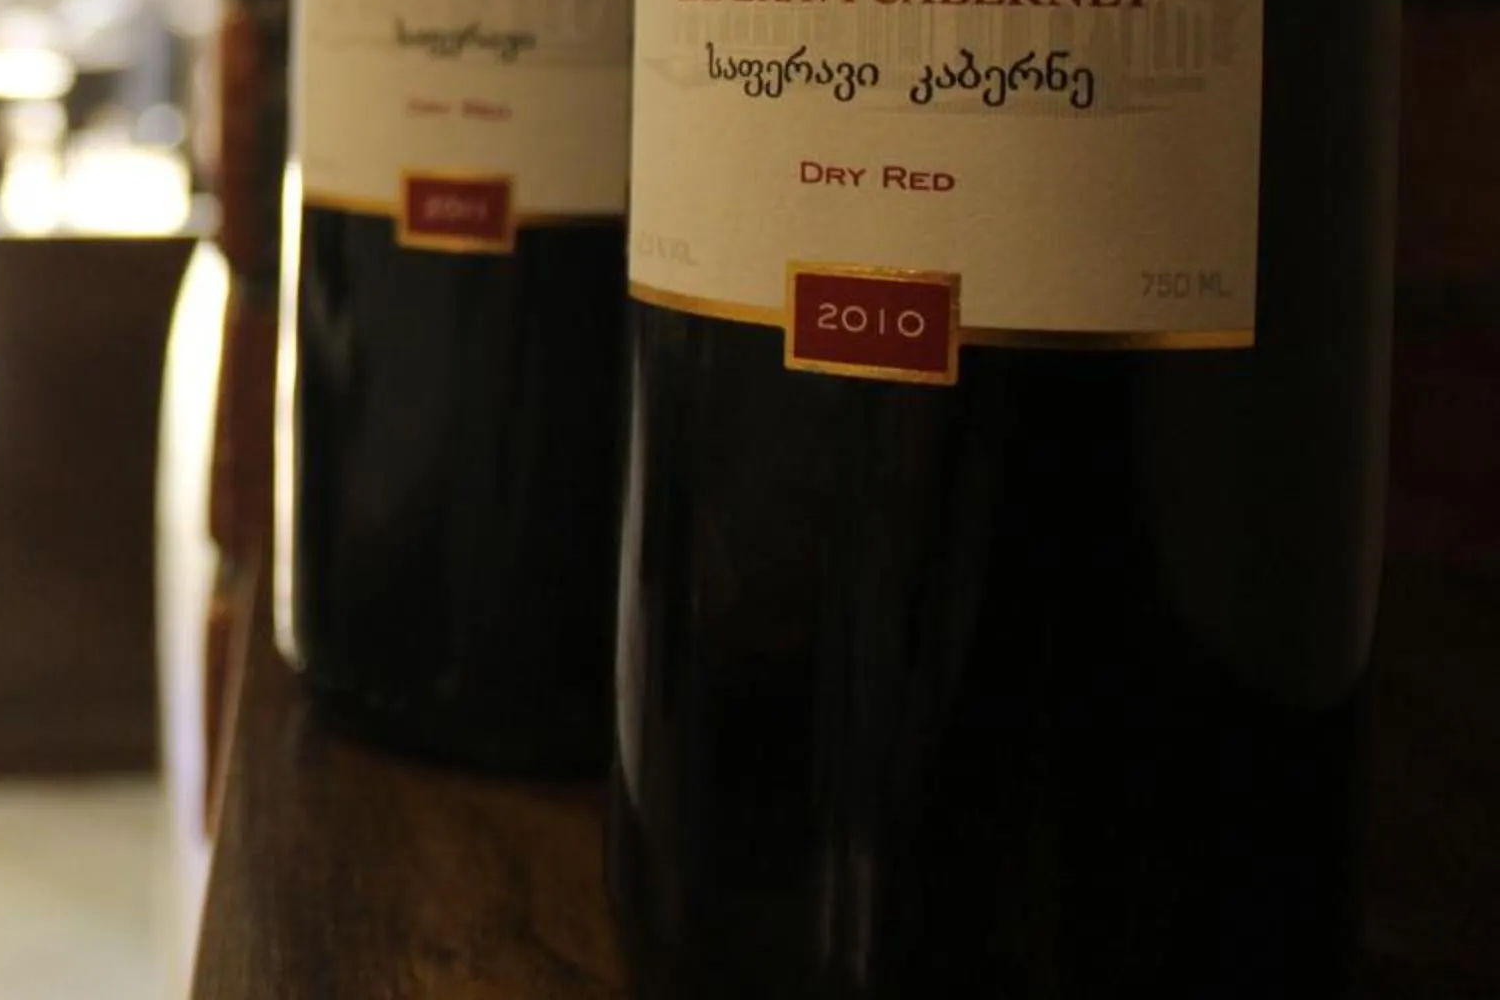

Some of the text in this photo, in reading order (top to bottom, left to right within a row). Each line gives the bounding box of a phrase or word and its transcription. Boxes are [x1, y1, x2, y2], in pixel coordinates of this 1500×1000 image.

[706, 42, 1096, 108] საფერავი კაბერნე
[1139, 270, 1235, 299] 750 ML
[817, 302, 925, 338] 2010
